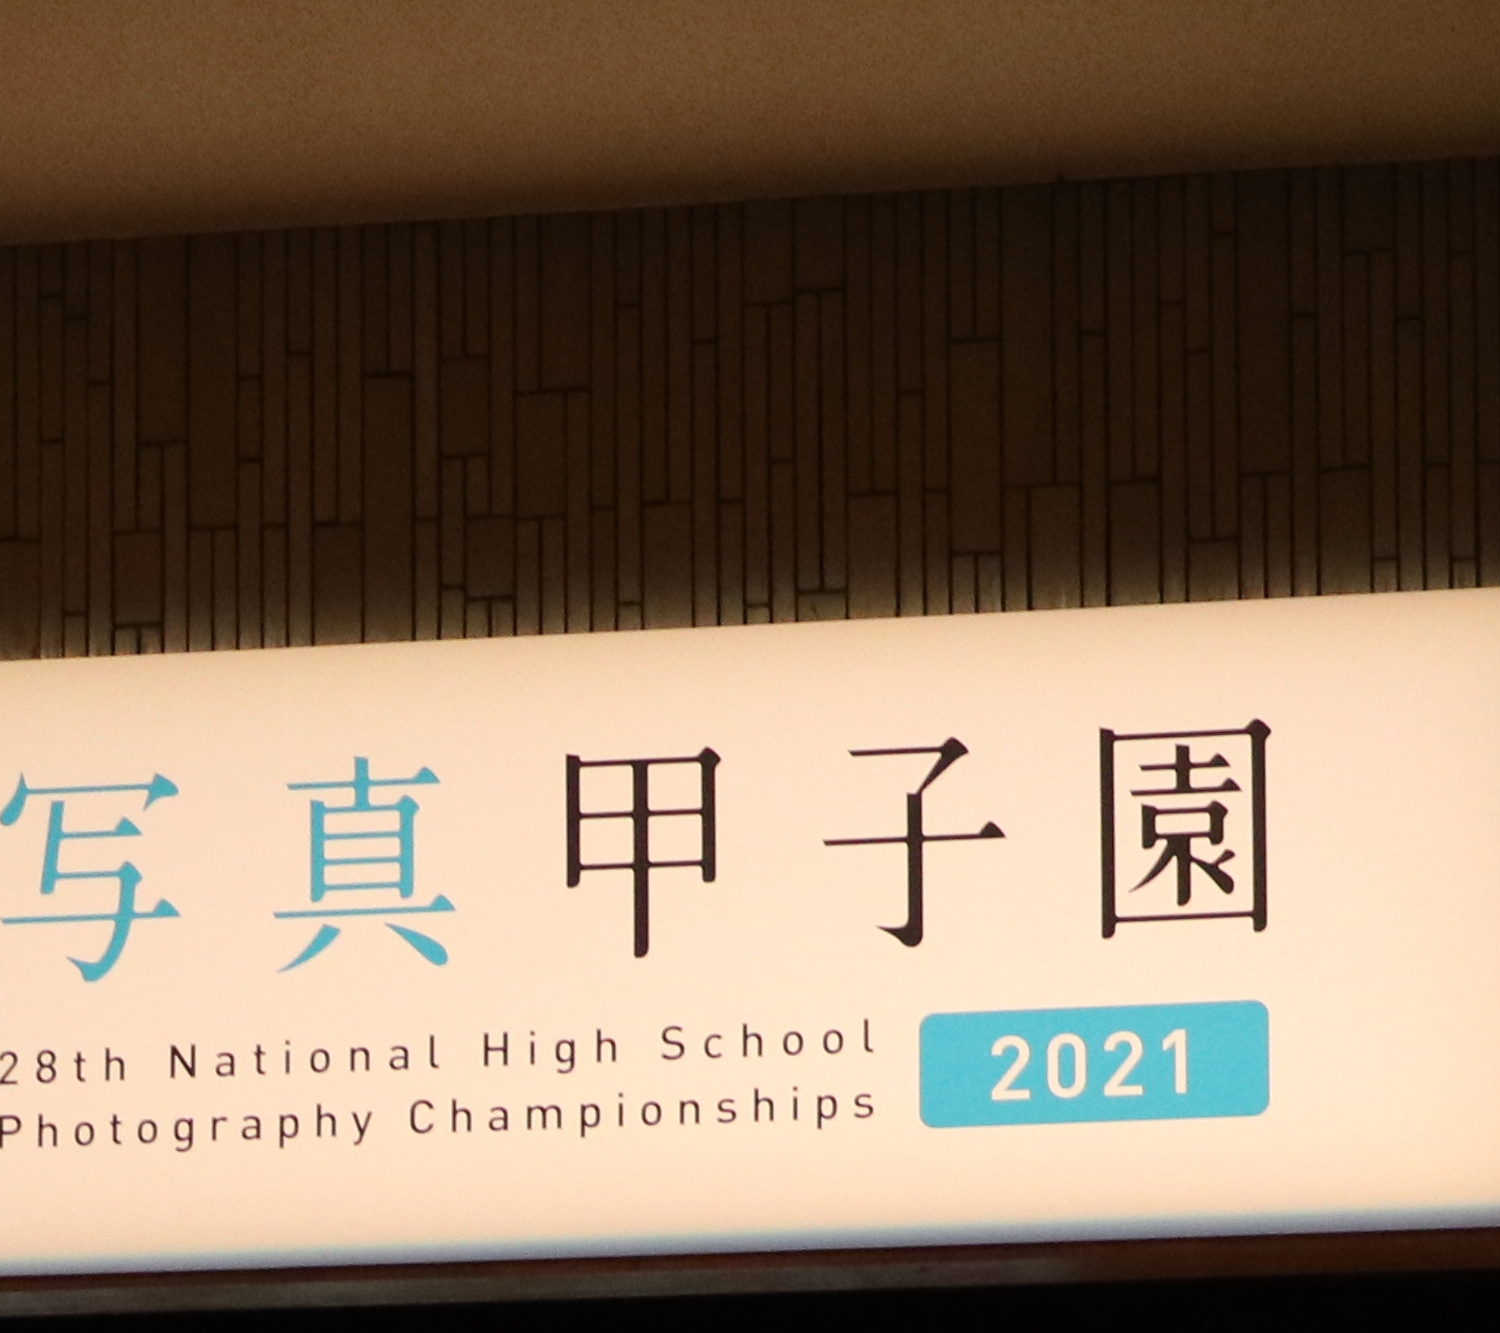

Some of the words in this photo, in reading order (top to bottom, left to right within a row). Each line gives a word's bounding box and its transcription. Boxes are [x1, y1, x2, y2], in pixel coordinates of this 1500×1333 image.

[168, 1031, 443, 1079] National
[480, 1027, 621, 1074] High
[659, 1018, 876, 1062] School
[990, 1027, 1195, 1104] 2021
[408, 1084, 876, 1138] Championships
